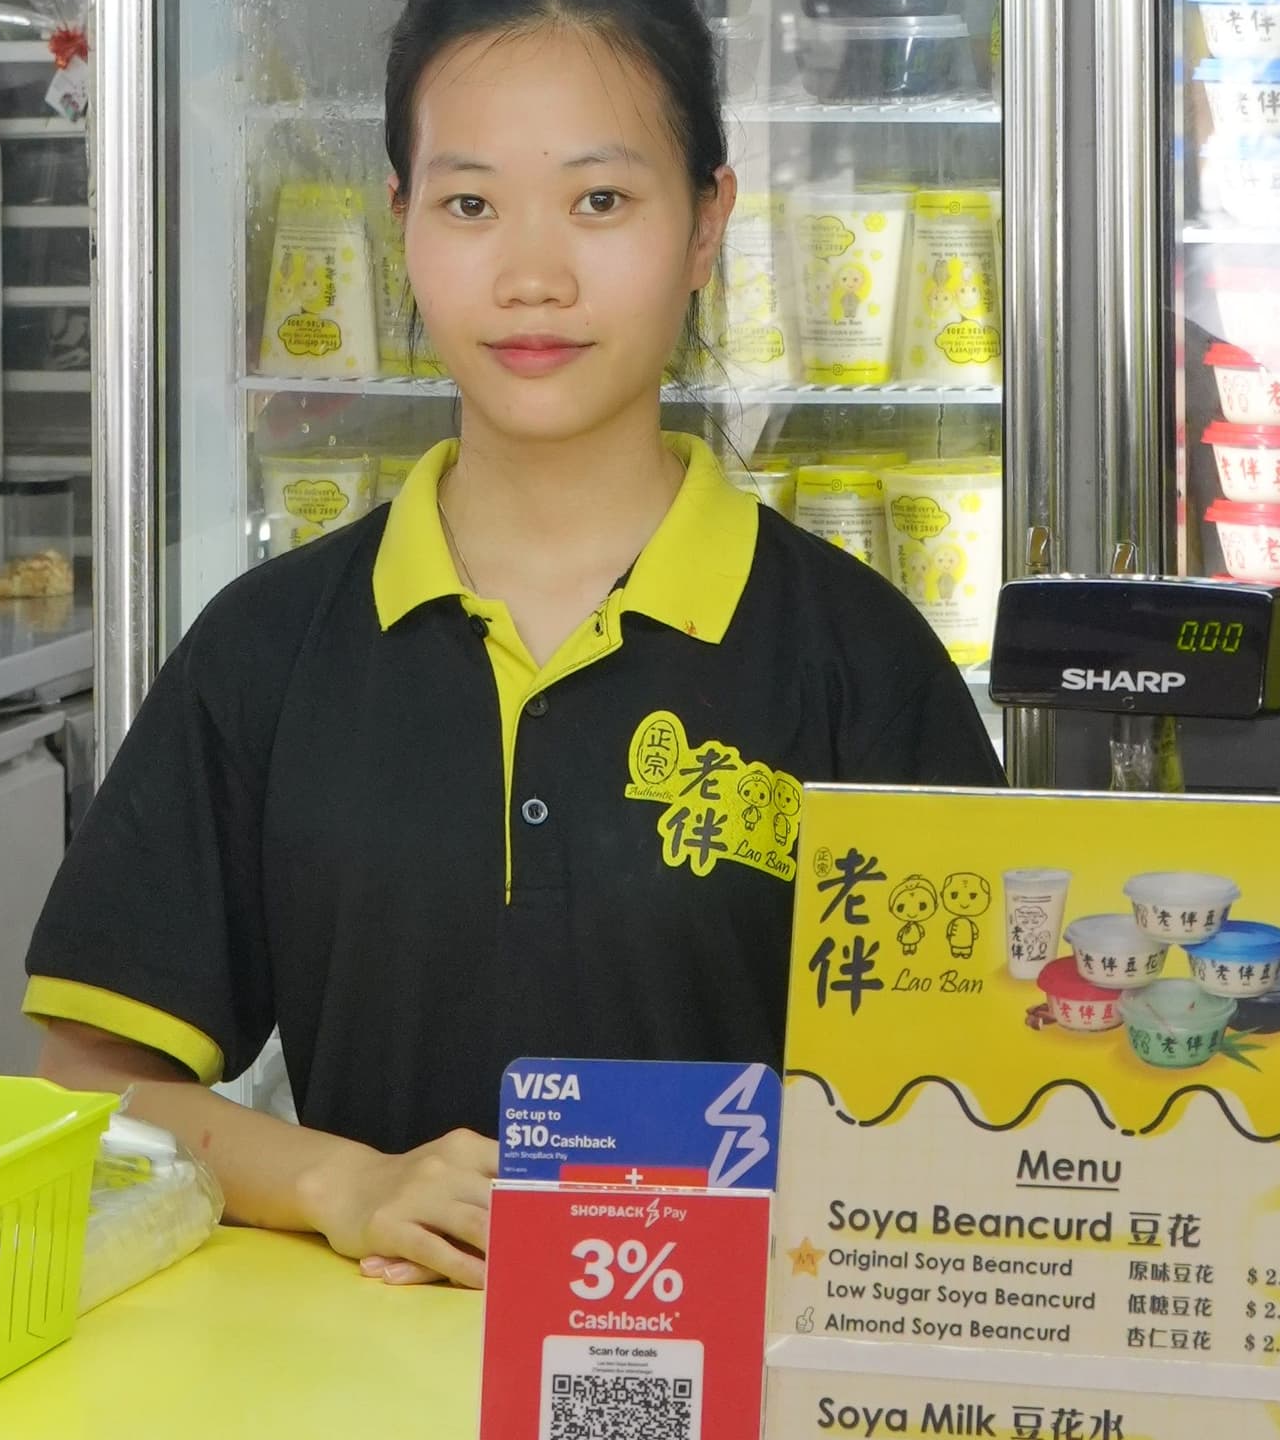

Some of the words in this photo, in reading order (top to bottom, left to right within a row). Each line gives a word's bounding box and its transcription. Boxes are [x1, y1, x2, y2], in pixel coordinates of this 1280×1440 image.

[1176, 621, 1243, 653] 0.00
[1061, 668, 1187, 694] SHARP
[666, 748, 738, 868] 老伴
[733, 839, 761, 863] Lao
[766, 851, 791, 876] Ban
[809, 847, 886, 1016] 老伴
[891, 968, 933, 994] Lao
[939, 968, 984, 996] Ban
[507, 1072, 581, 1101] VISA
[505, 1122, 549, 1149] $10
[550, 1134, 616, 1149] Cashback
[1016, 1149, 1122, 1183] Menu
[570, 1204, 644, 1218] SHOPBACK
[663, 1206, 687, 1221] Pay
[828, 1200, 918, 1239] Soya
[932, 1205, 1112, 1242] Beancurd
[1128, 1211, 1201, 1248] 豆花
[569, 1238, 684, 1303] 3%
[828, 1249, 908, 1270] Original
[915, 1253, 965, 1273] Soya
[973, 1255, 1073, 1276] Beancurd
[1128, 1261, 1214, 1284] 原味豆花
[827, 1280, 866, 1298] Low
[872, 1283, 931, 1304] Sugar
[937, 1286, 987, 1307] Soya
[995, 1289, 1095, 1310] Beancurd
[1128, 1294, 1213, 1316] 低糖豆花
[824, 1314, 905, 1334] Almond
[912, 1318, 962, 1340] Soya
[970, 1321, 1070, 1342] Beancurd
[1127, 1327, 1211, 1350] 杏仁豆花
[589, 1346, 613, 1356] Scan
[615, 1347, 629, 1357] for
[632, 1348, 658, 1358] deals
[817, 1397, 908, 1438] Soya
[921, 1403, 996, 1437] Milk
